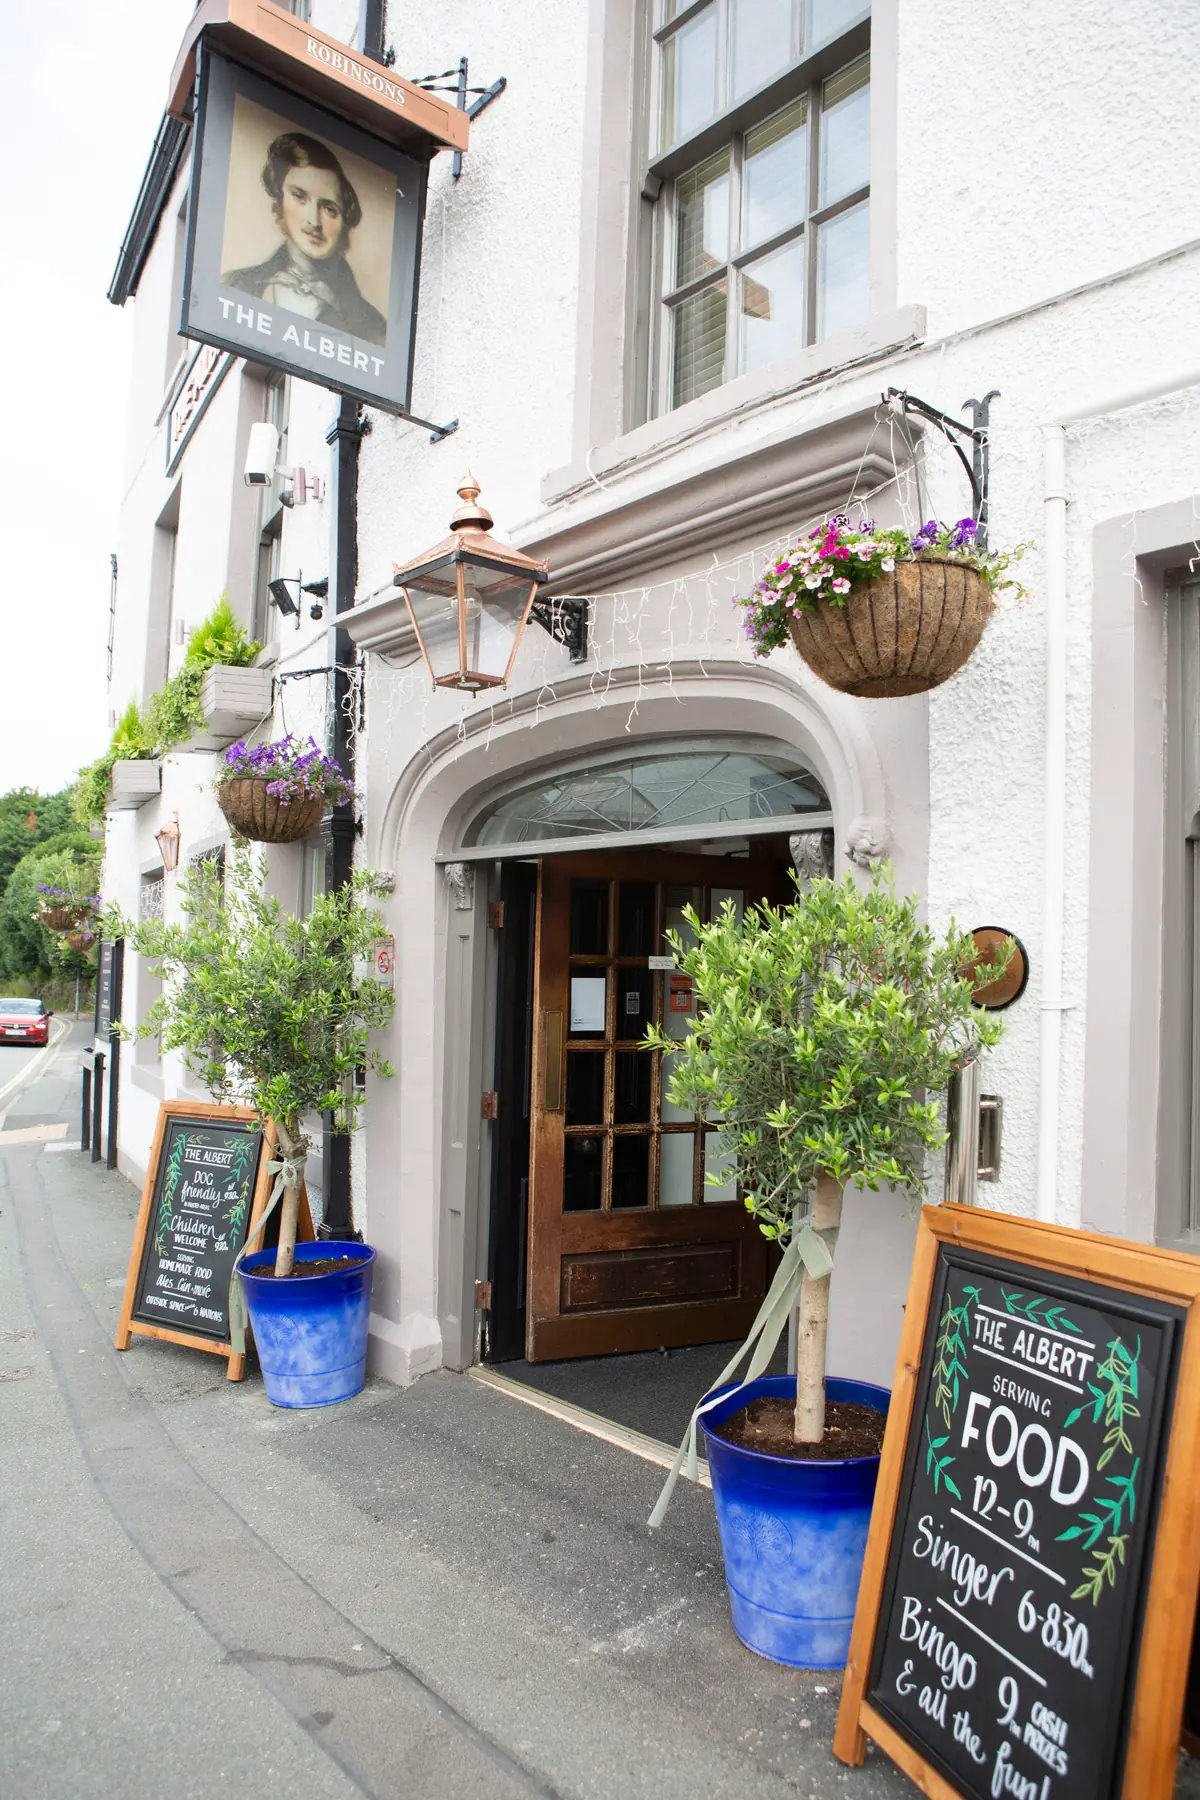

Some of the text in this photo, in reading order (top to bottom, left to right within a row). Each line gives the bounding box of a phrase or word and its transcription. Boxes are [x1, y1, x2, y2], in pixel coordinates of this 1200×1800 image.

[307, 37, 405, 104] ROBINSONS
[218, 297, 385, 376] THE ALBERT
[185, 1148, 233, 1164] THE ALBERT
[193, 1171, 213, 1185] DOG
[181, 1180, 225, 1208] friendly
[171, 1215, 219, 1239] Children
[174, 1233, 208, 1249] WELCOME
[159, 1259, 212, 1280] HOMEMADE FOOD
[146, 1295, 168, 1308] OUTSIDE
[193, 1306, 199, 1316] 6
[199, 1307, 223, 1322] NATIONS
[974, 1313, 1095, 1381] THE ALBERT
[992, 1374, 1051, 1418] SERVING
[961, 1391, 1089, 1505] FOOD
[913, 1515, 1014, 1607] Singer
[900, 1596, 978, 1690] Bingo
[918, 1685, 948, 1729] all
[953, 1711, 987, 1764] the
[1031, 1701, 1068, 1747] CASH
[1023, 1722, 1068, 1776] PRIZES
